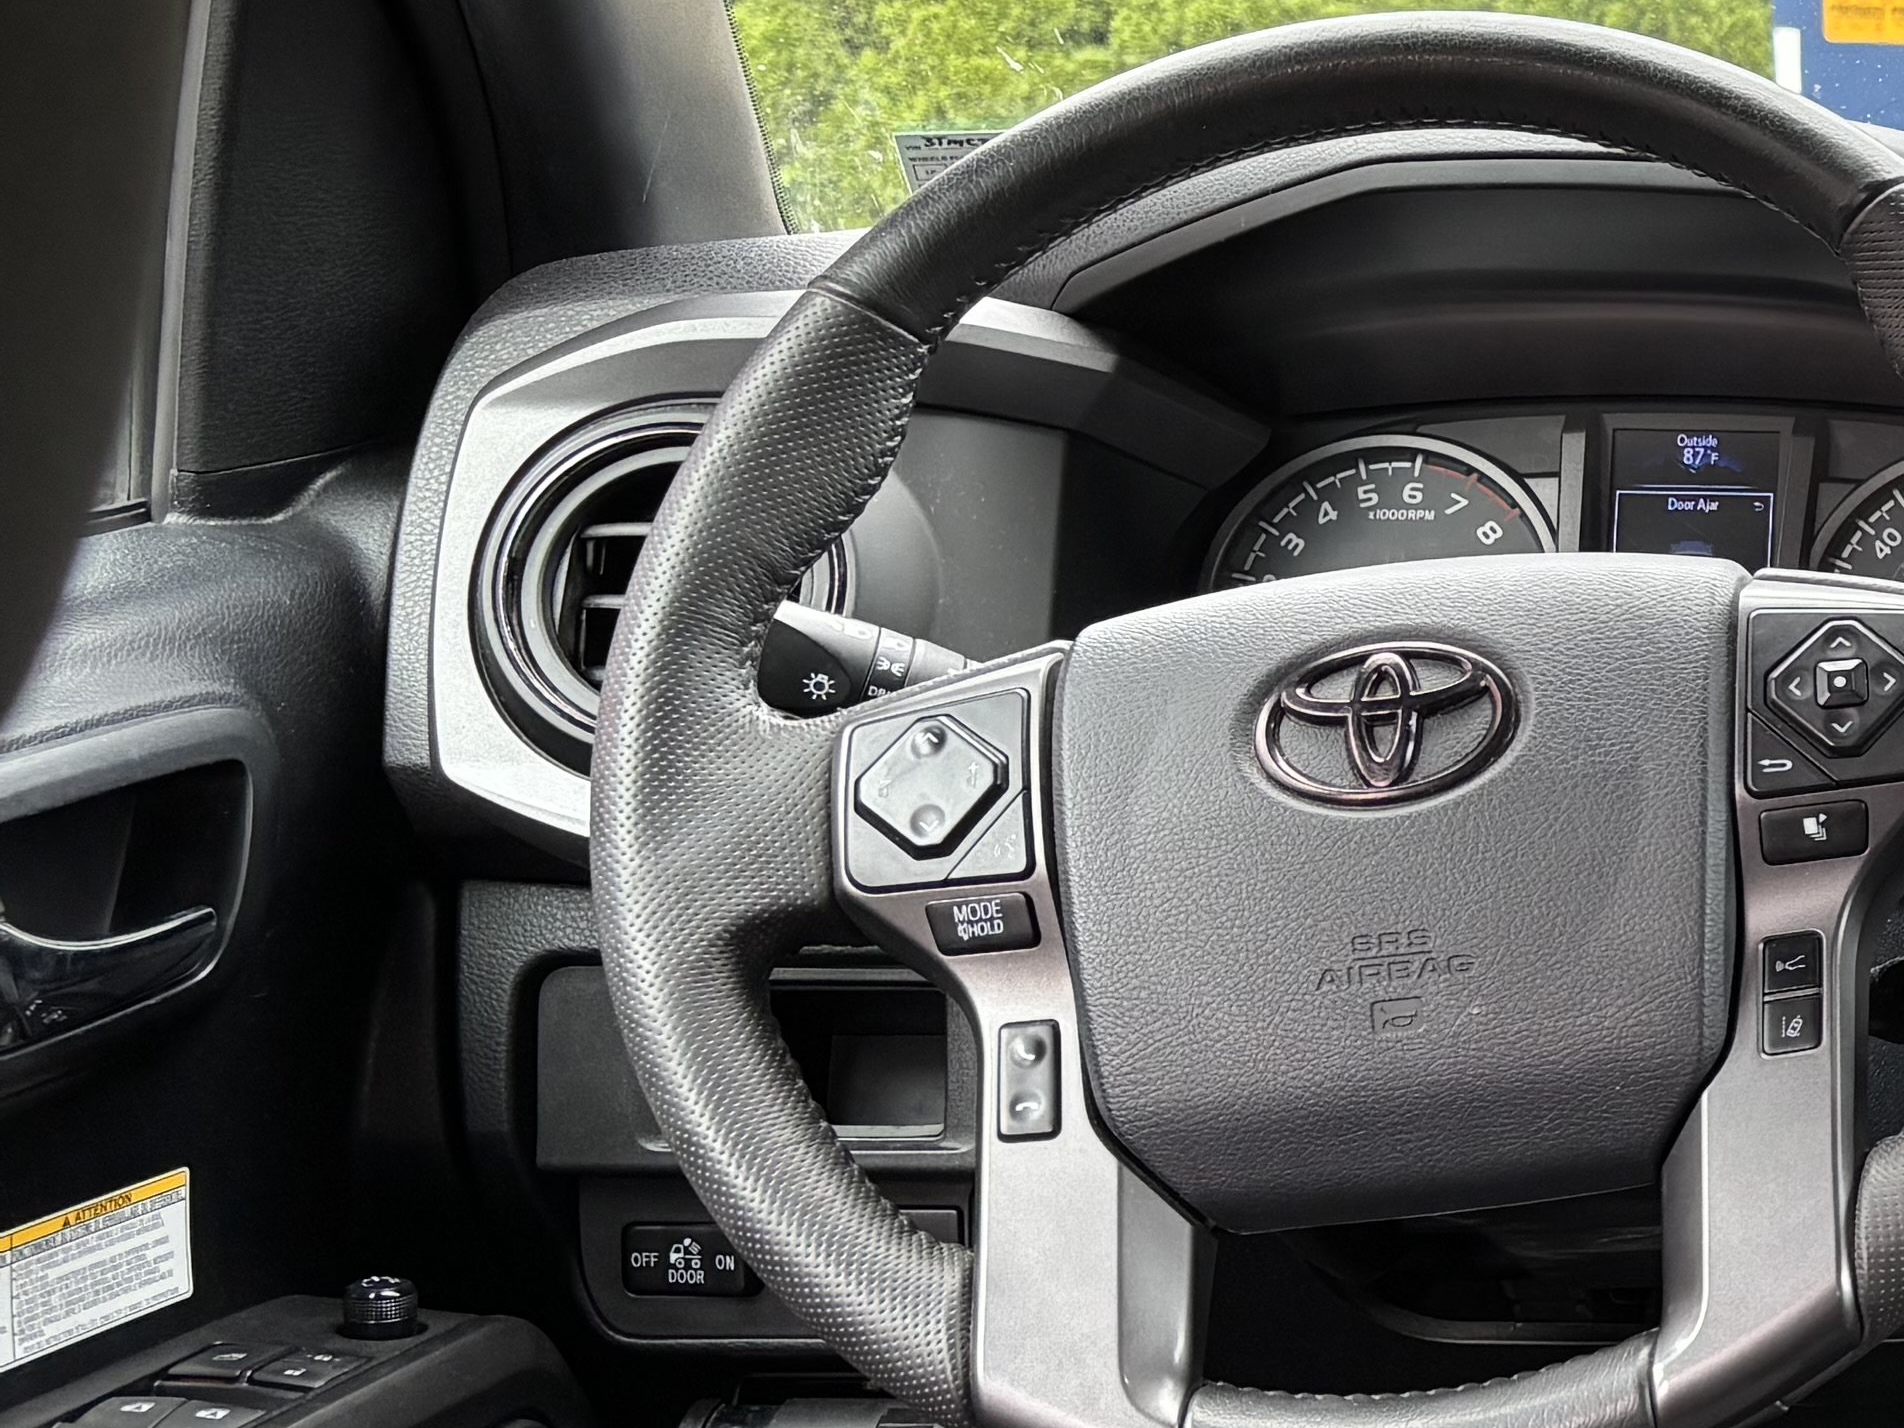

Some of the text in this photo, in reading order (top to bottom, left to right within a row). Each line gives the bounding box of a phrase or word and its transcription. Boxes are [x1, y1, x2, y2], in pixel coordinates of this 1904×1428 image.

[1676, 433, 1718, 448] Outside
[1357, 483, 1379, 508] 5
[1402, 482, 1424, 504] 6
[1444, 492, 1469, 515] 7
[1318, 500, 1339, 524] 4
[1667, 497, 1720, 513] Door Ajar
[1280, 531, 1306, 557] 3
[1476, 520, 1503, 546] 8
[1874, 527, 1902, 560] 40
[952, 900, 1003, 923] MODE
[969, 920, 1004, 938] HOLD
[1351, 928, 1432, 953] SRS
[1315, 953, 1477, 992] AIRBAG
[74, 1192, 134, 1224] ATTENTION
[631, 1252, 660, 1268] OFF
[715, 1254, 735, 1271] ON
[668, 1269, 705, 1285] DOOR
